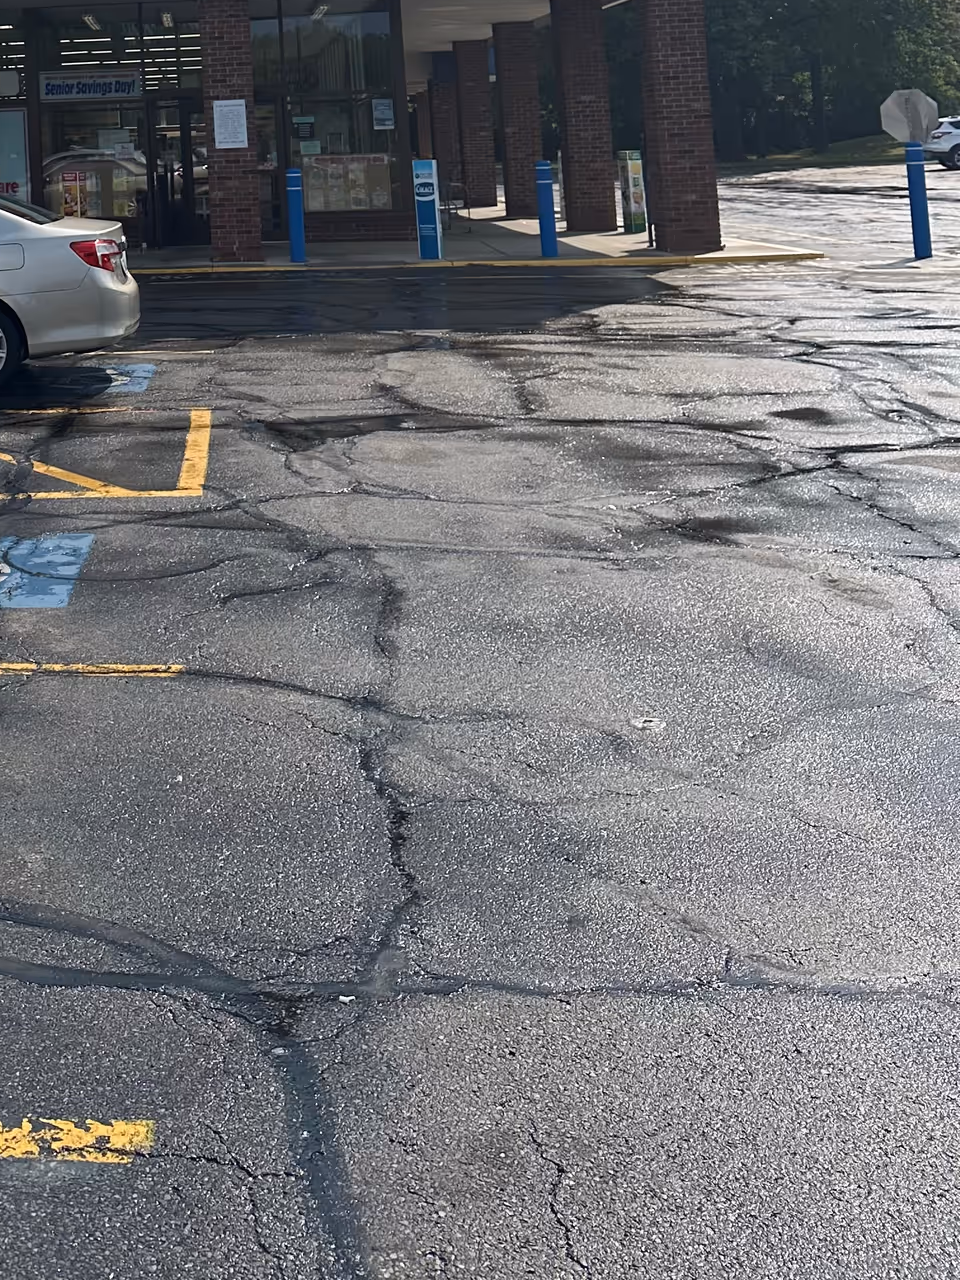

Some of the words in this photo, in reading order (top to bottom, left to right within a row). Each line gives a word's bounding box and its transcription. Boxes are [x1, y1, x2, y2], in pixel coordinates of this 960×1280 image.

[44, 81, 74, 96] Senior
[75, 79, 113, 96] Savings
[114, 78, 136, 95] Day!
